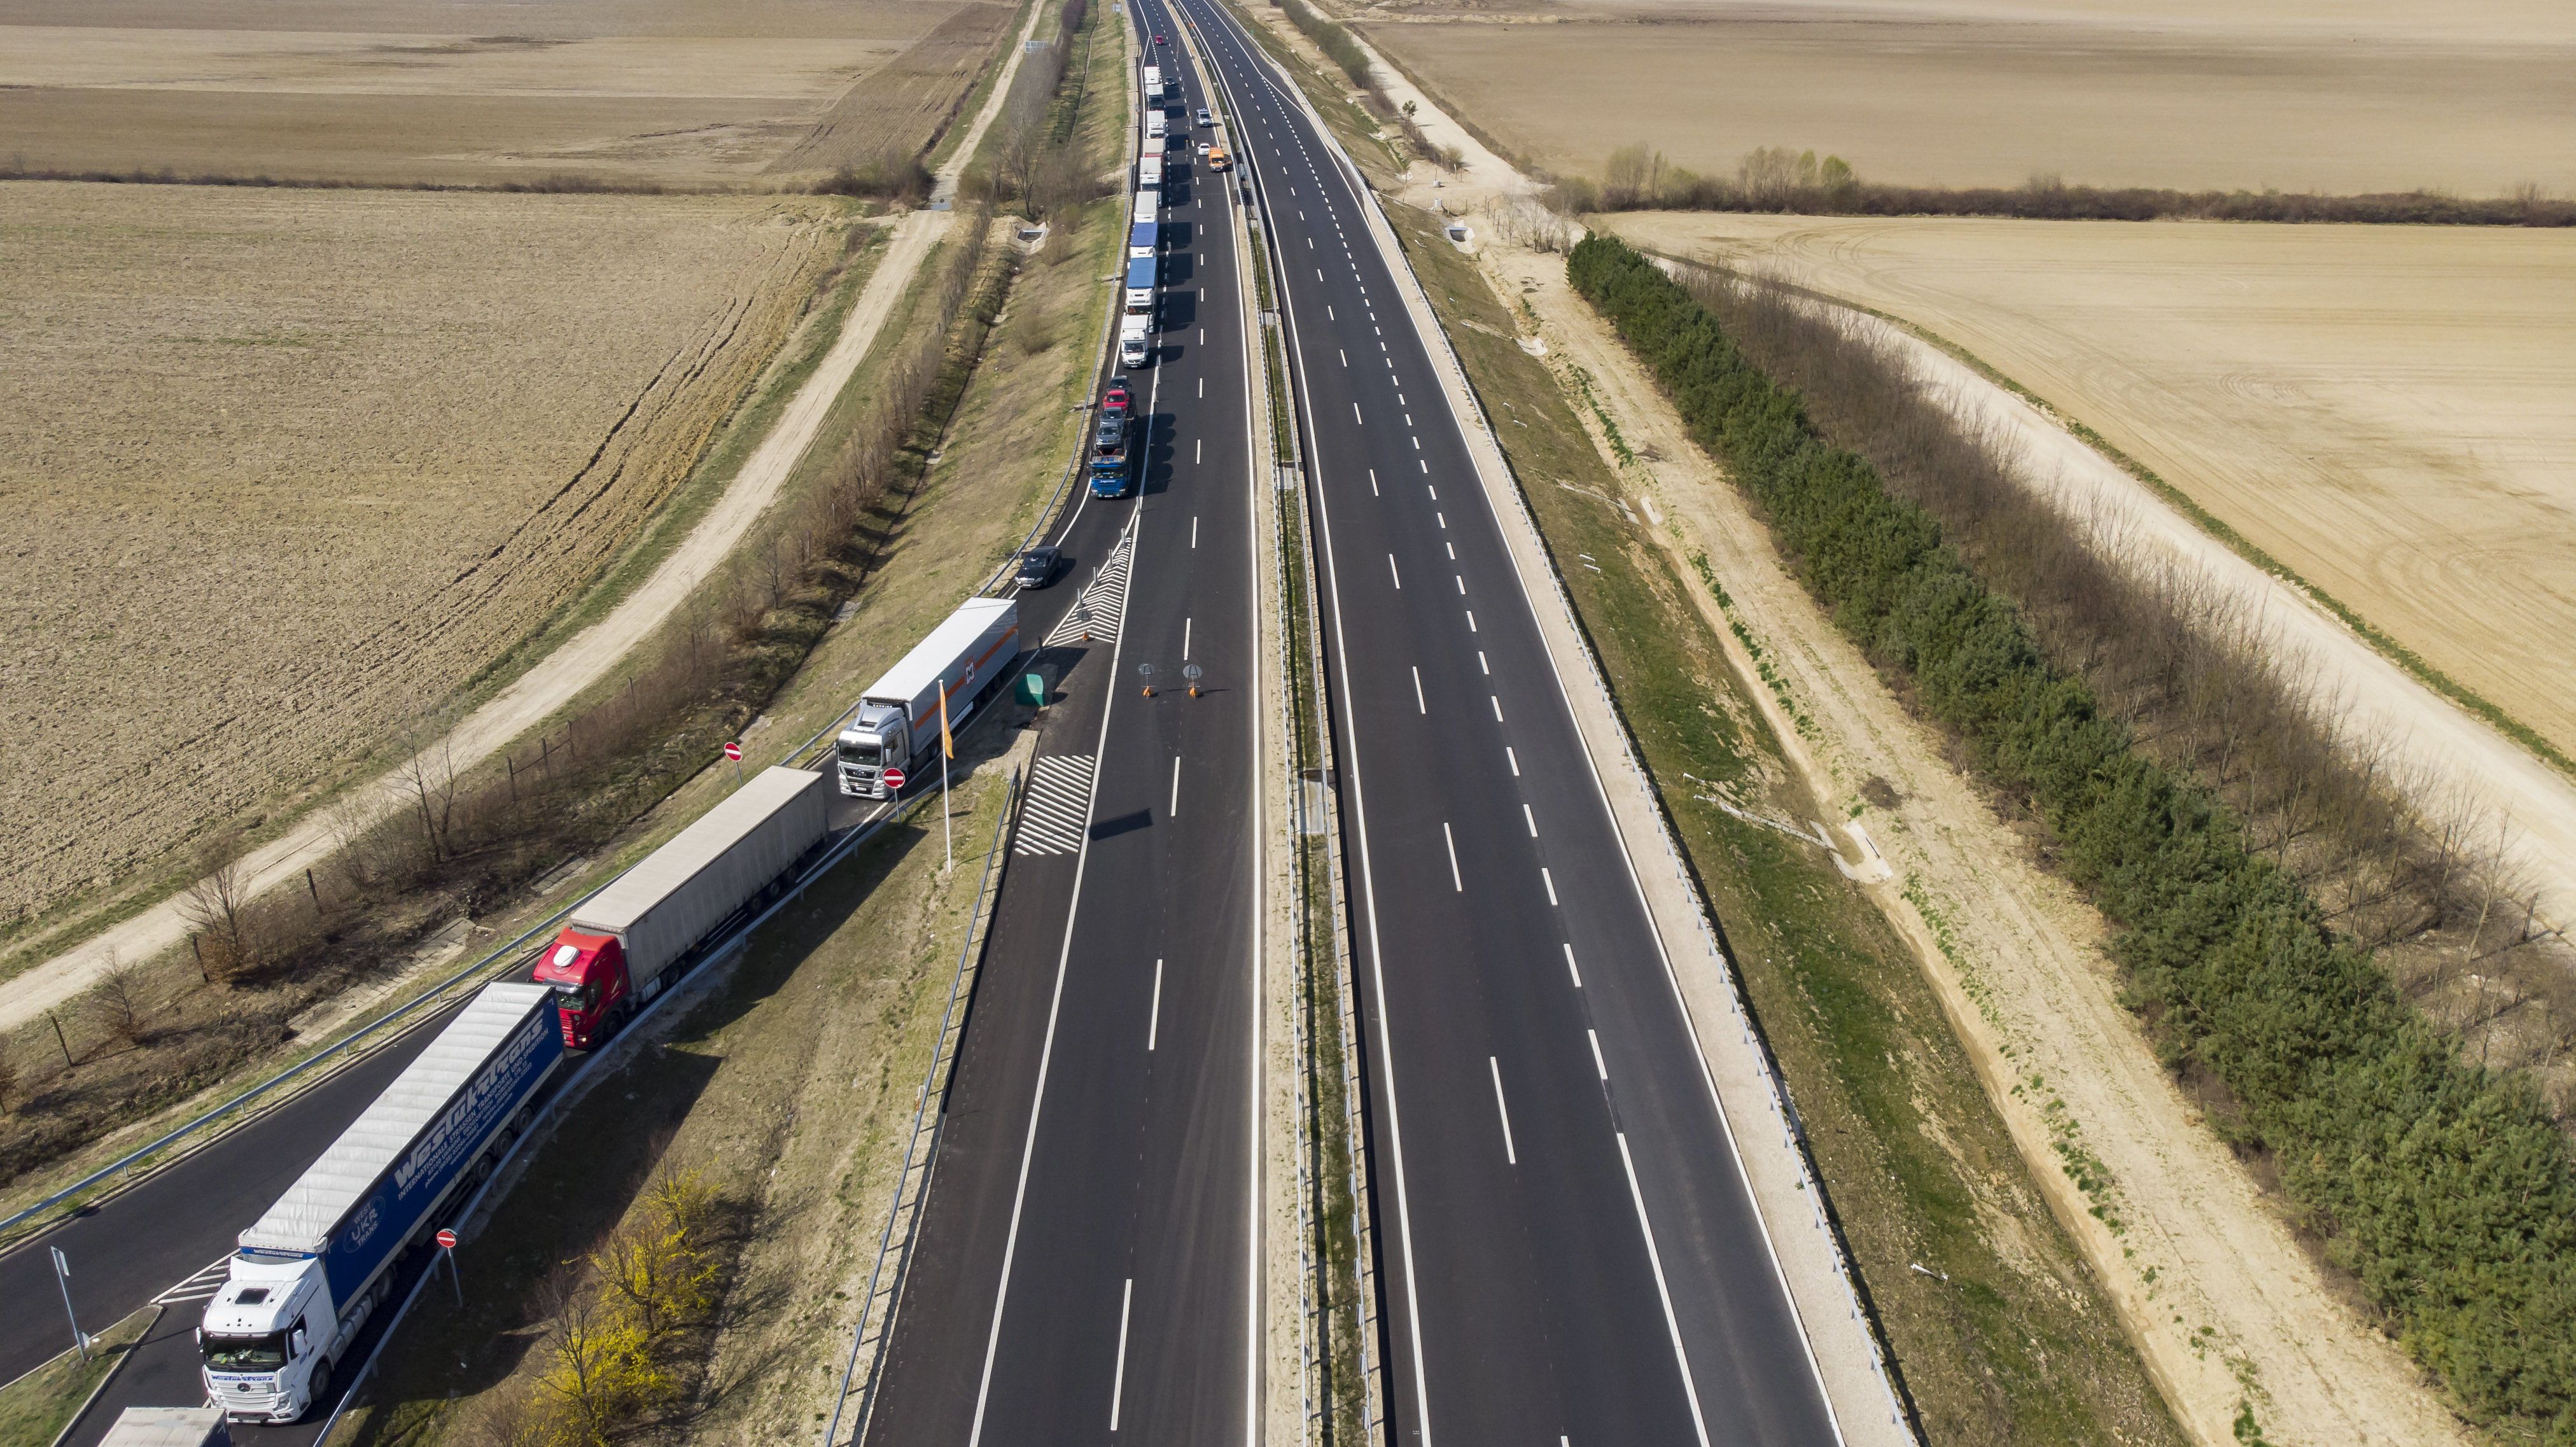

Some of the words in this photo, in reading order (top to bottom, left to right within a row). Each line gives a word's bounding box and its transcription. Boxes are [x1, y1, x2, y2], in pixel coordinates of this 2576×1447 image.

[398, 1140, 448, 1201] INTERNATIONALE
[449, 1109, 476, 1143] STRASSEN
[478, 1070, 510, 1111] TRANSPORTE
[511, 1056, 523, 1073] UND
[523, 1027, 549, 1060] SPEDITION
[351, 1208, 377, 1241] UKR
[354, 1203, 371, 1224] WEST
[356, 1222, 377, 1247] TRANS
